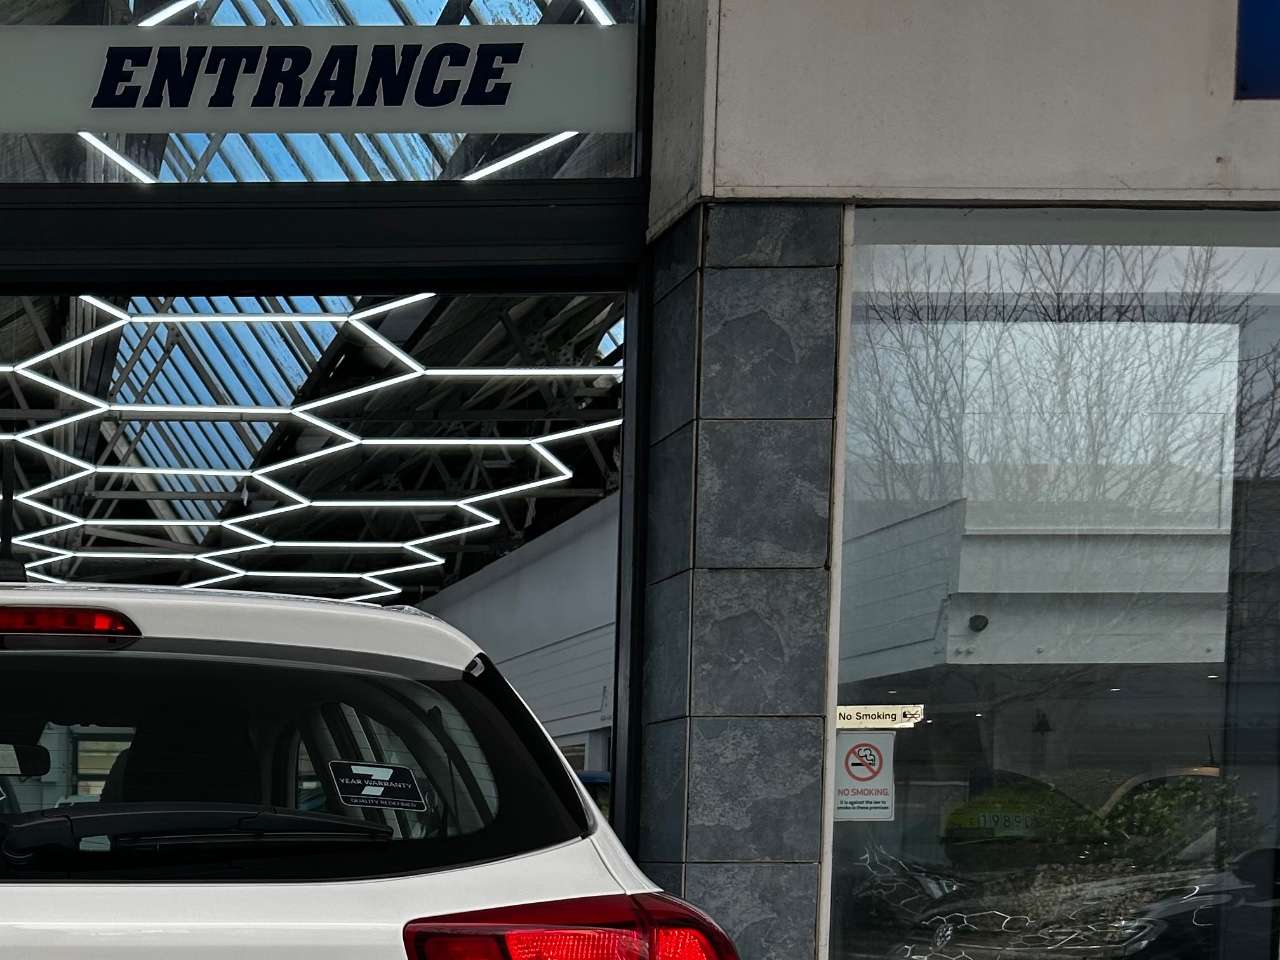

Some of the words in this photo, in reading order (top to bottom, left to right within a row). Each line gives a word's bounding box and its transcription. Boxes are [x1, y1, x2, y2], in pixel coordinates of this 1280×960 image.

[90, 42, 525, 109] ENTRANCE
[838, 712, 852, 721] No
[856, 712, 897, 722] Smoking
[364, 780, 412, 789] WARRANTY
[838, 788, 849, 796] NO
